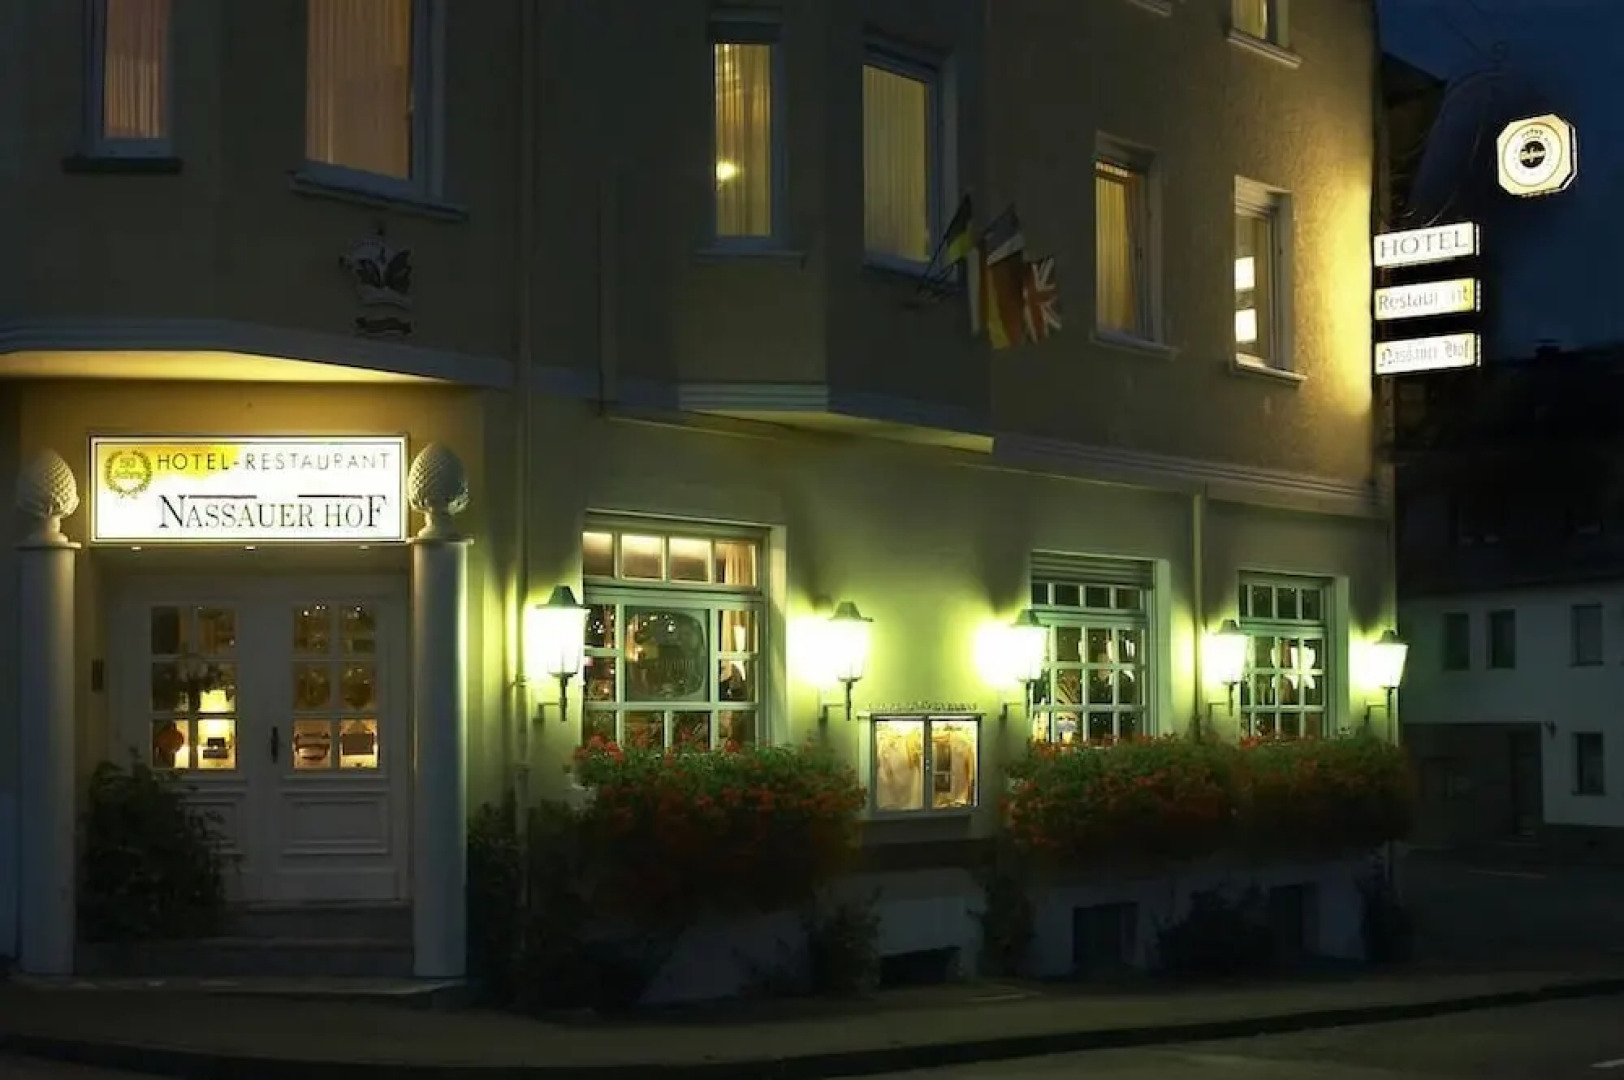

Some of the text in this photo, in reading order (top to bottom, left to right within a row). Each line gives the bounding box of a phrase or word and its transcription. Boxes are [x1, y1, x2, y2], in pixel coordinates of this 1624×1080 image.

[1381, 230, 1468, 258] HOTEL
[1378, 285, 1469, 311] Restaurnt
[158, 494, 315, 529] NASSAUER
